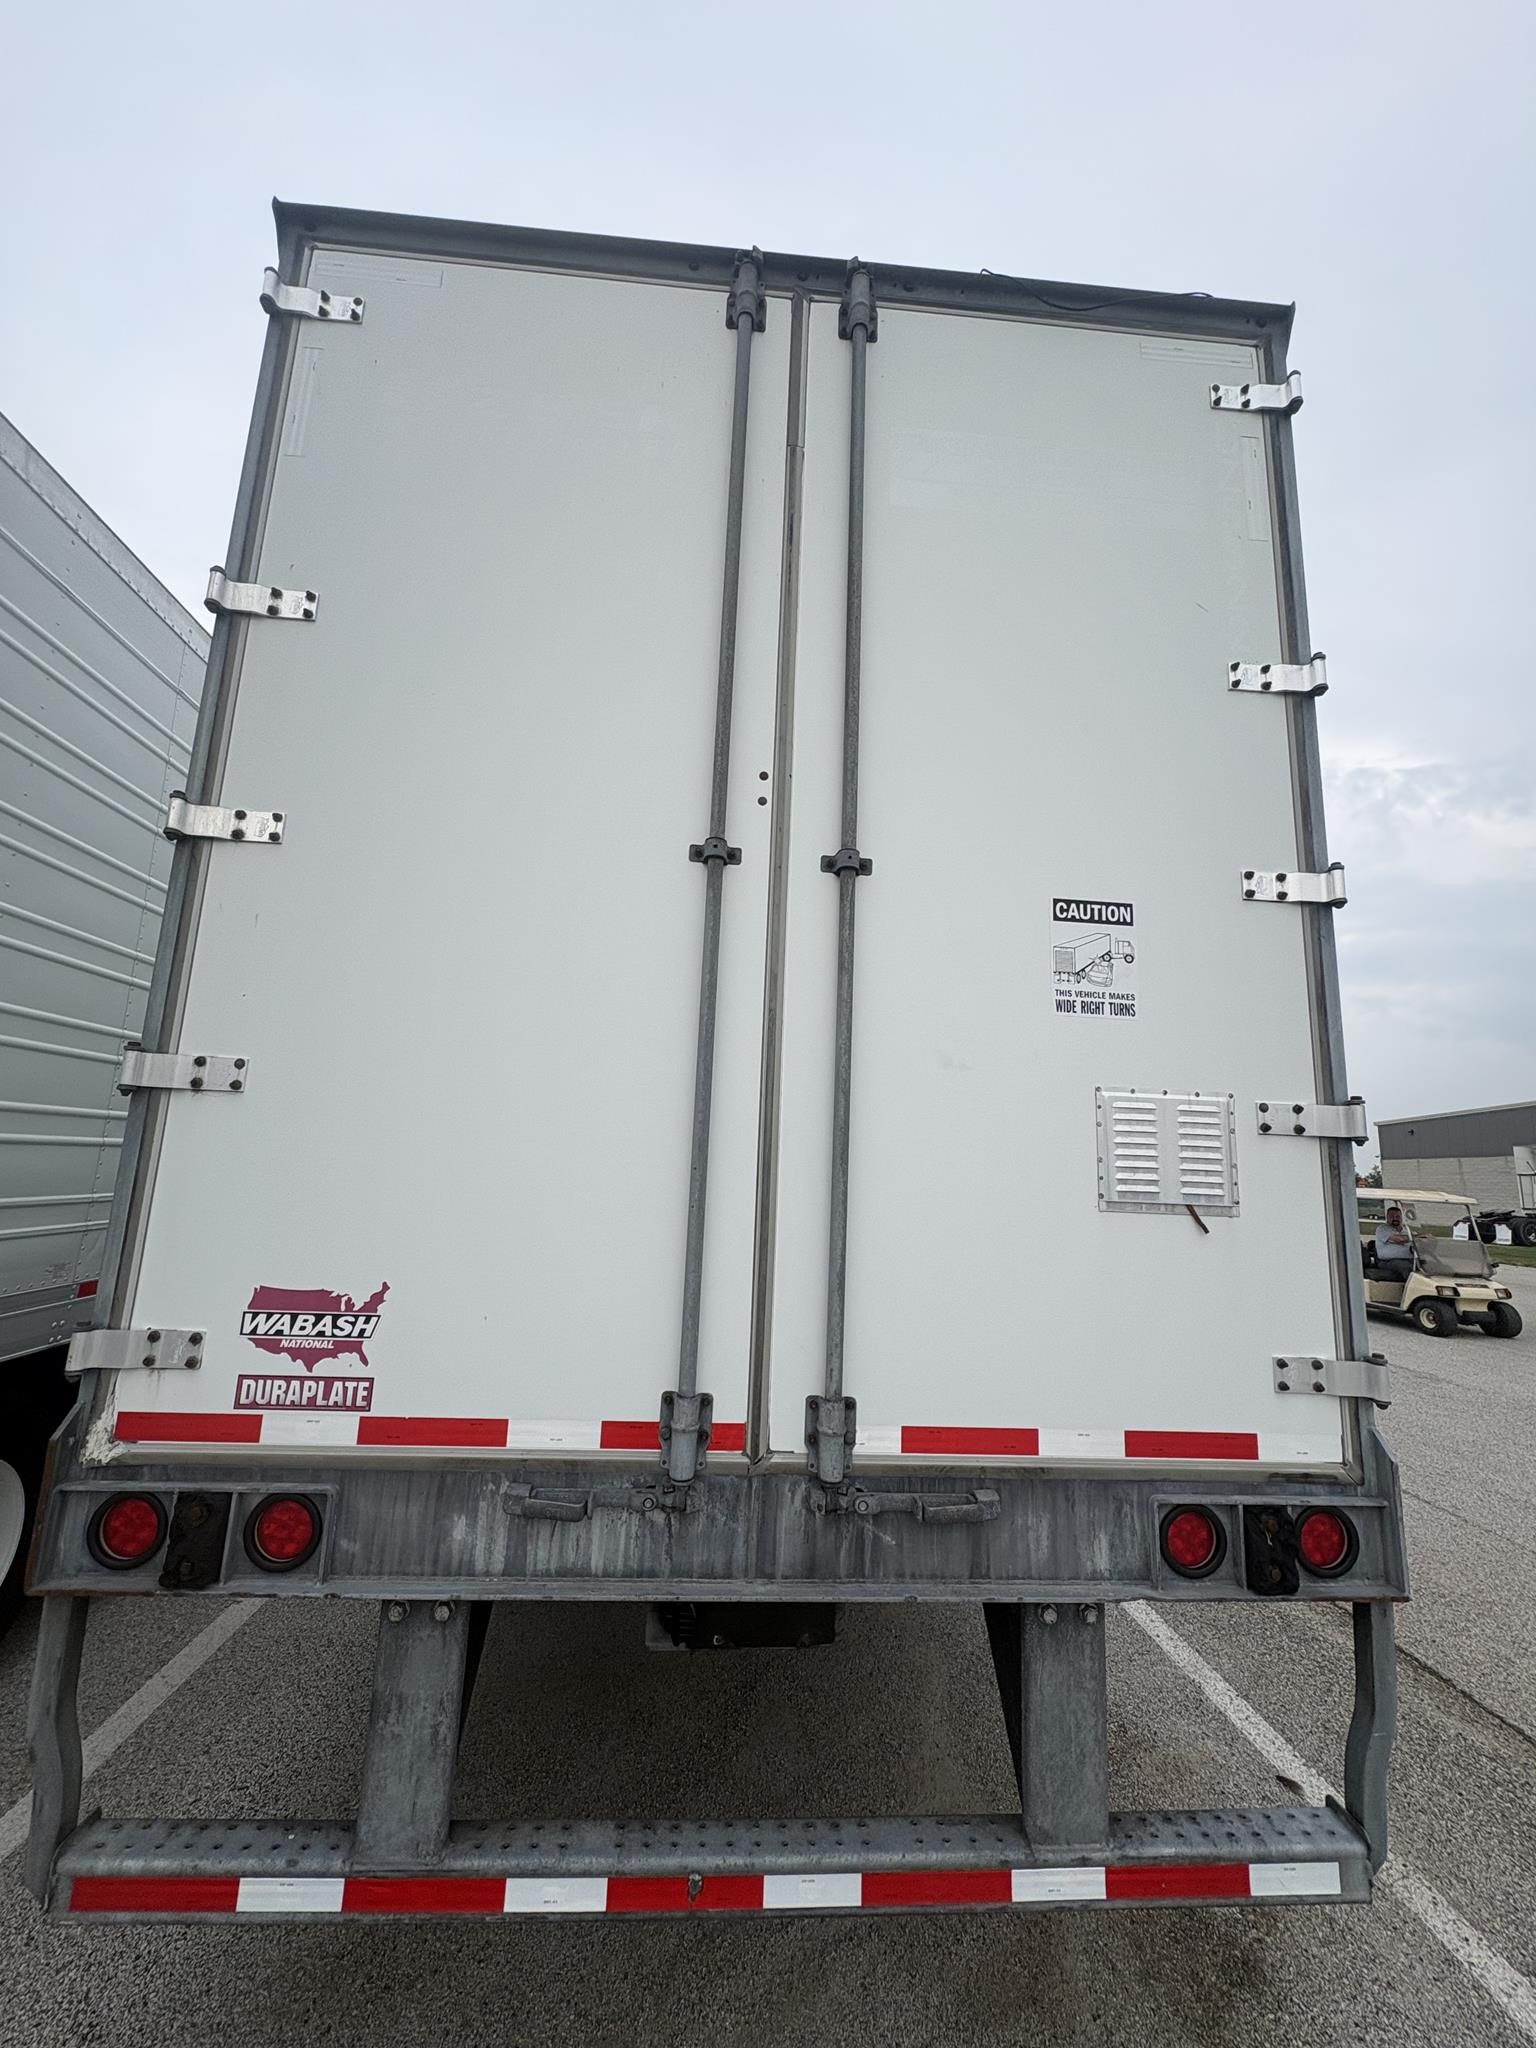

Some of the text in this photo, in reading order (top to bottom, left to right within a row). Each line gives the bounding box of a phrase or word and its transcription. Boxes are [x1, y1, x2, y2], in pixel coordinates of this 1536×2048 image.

[1055, 902, 1131, 923] CAUTION
[1055, 989, 1135, 1001] THIS VEHICLE MAKES
[1055, 999, 1136, 1017] WIDE RIGHT TURNS
[242, 1313, 378, 1337] WABASH
[279, 1339, 334, 1349] NATIONAL
[239, 1379, 369, 1407] DURAPLATE
